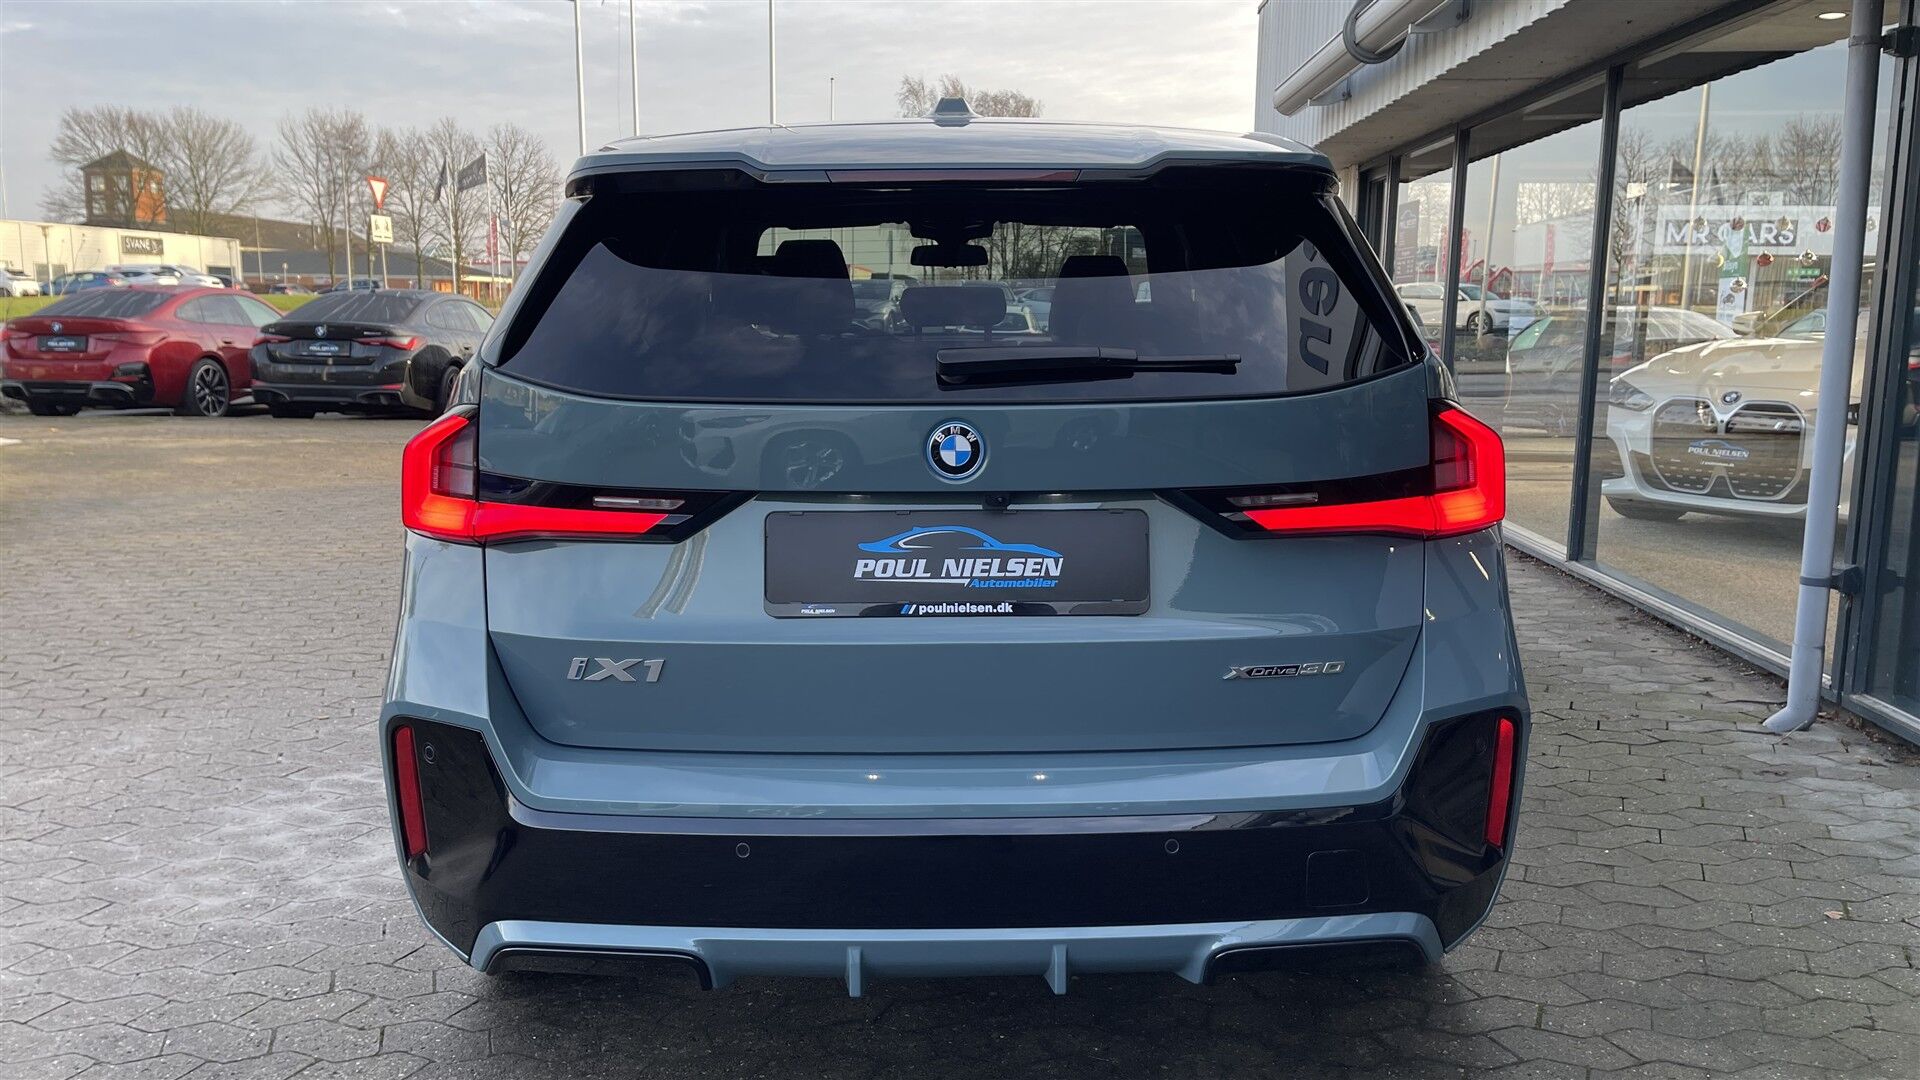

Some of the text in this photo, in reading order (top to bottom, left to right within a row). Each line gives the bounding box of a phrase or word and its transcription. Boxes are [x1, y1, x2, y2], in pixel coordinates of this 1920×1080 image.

[1666, 222, 1710, 244] MR
[125, 238, 151, 251] SVANE
[934, 426, 977, 443] BMW
[1687, 446, 1749, 457] POUL NIELSEN
[854, 557, 1063, 578] POUL NIELSEN
[969, 578, 1059, 588] Automobiler
[918, 602, 1013, 616] poulnielsen.dk
[566, 657, 665, 683] iX1
